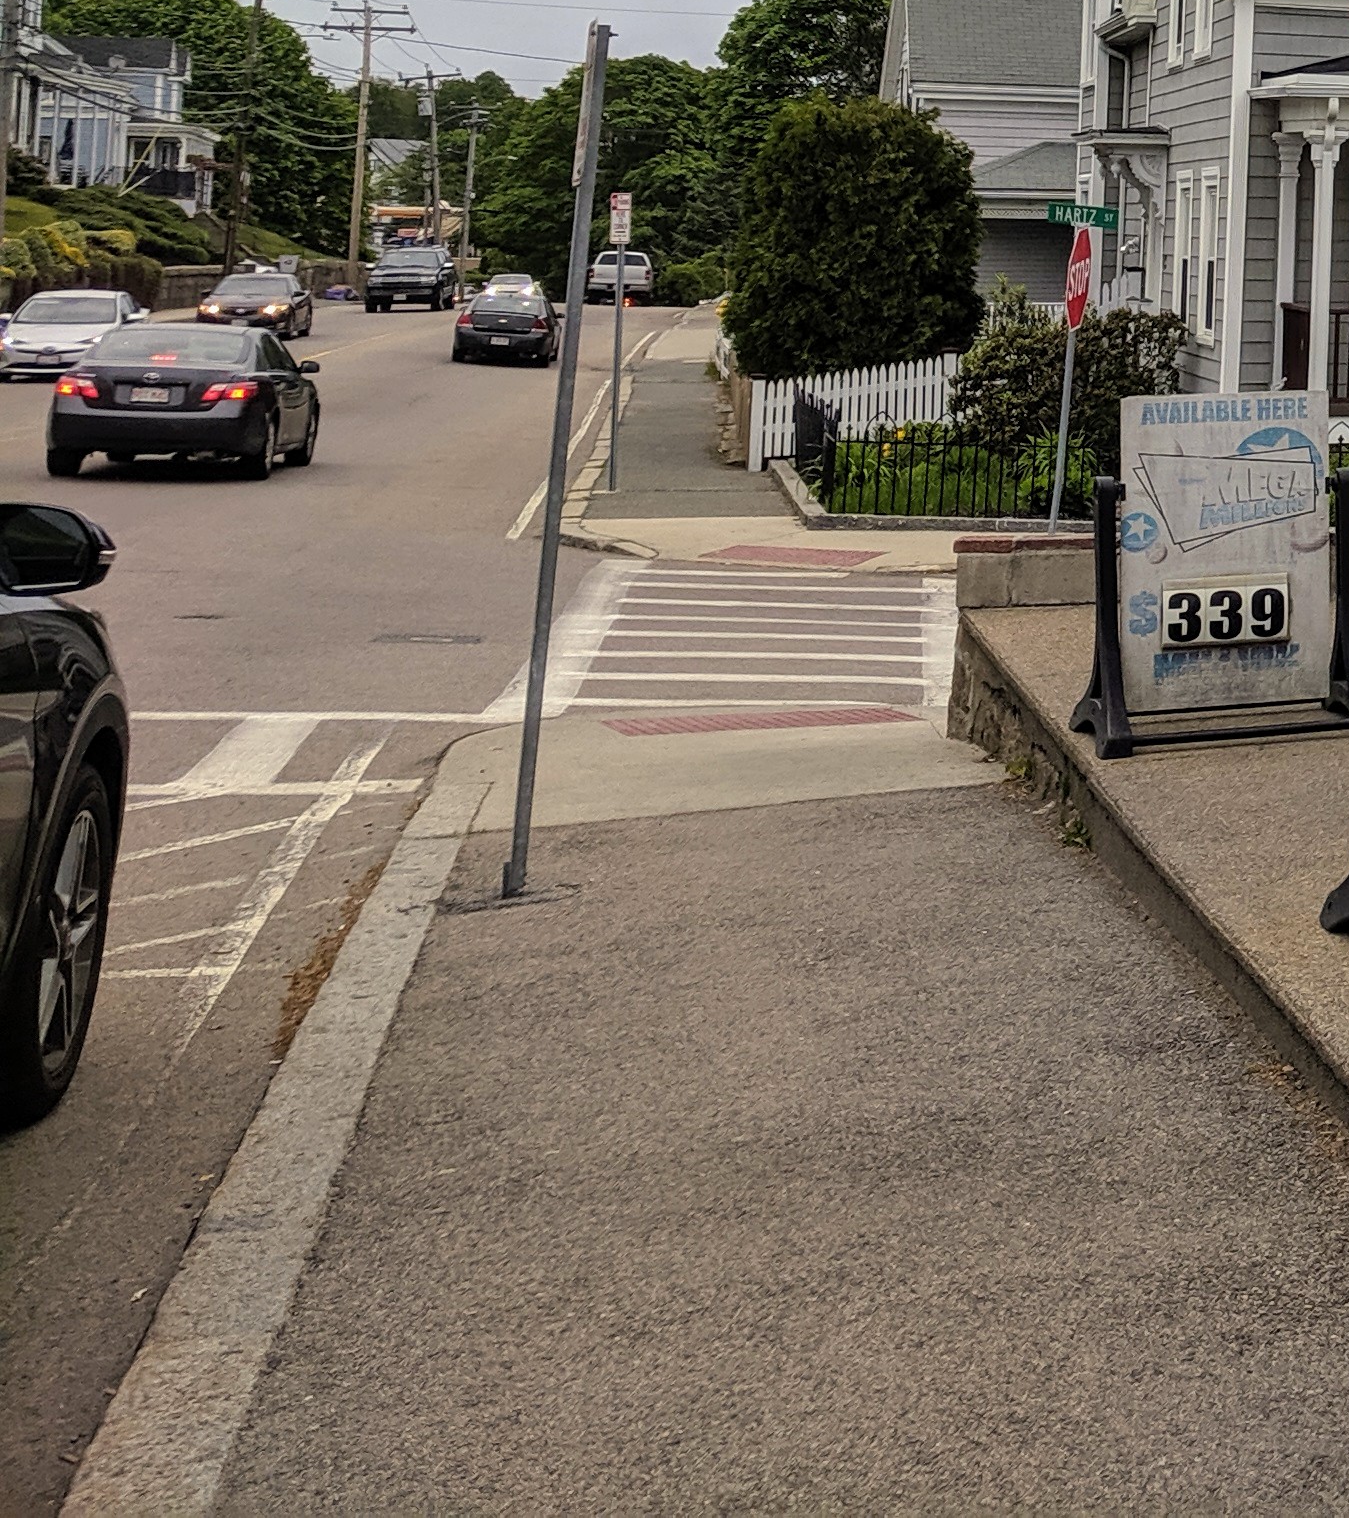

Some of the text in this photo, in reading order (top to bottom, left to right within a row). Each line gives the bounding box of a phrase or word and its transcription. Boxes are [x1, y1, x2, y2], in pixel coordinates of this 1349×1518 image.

[1054, 206, 1098, 224] HARTZ
[1068, 257, 1090, 301] STOP
[1140, 396, 1309, 425] AVAILABLE HERE
